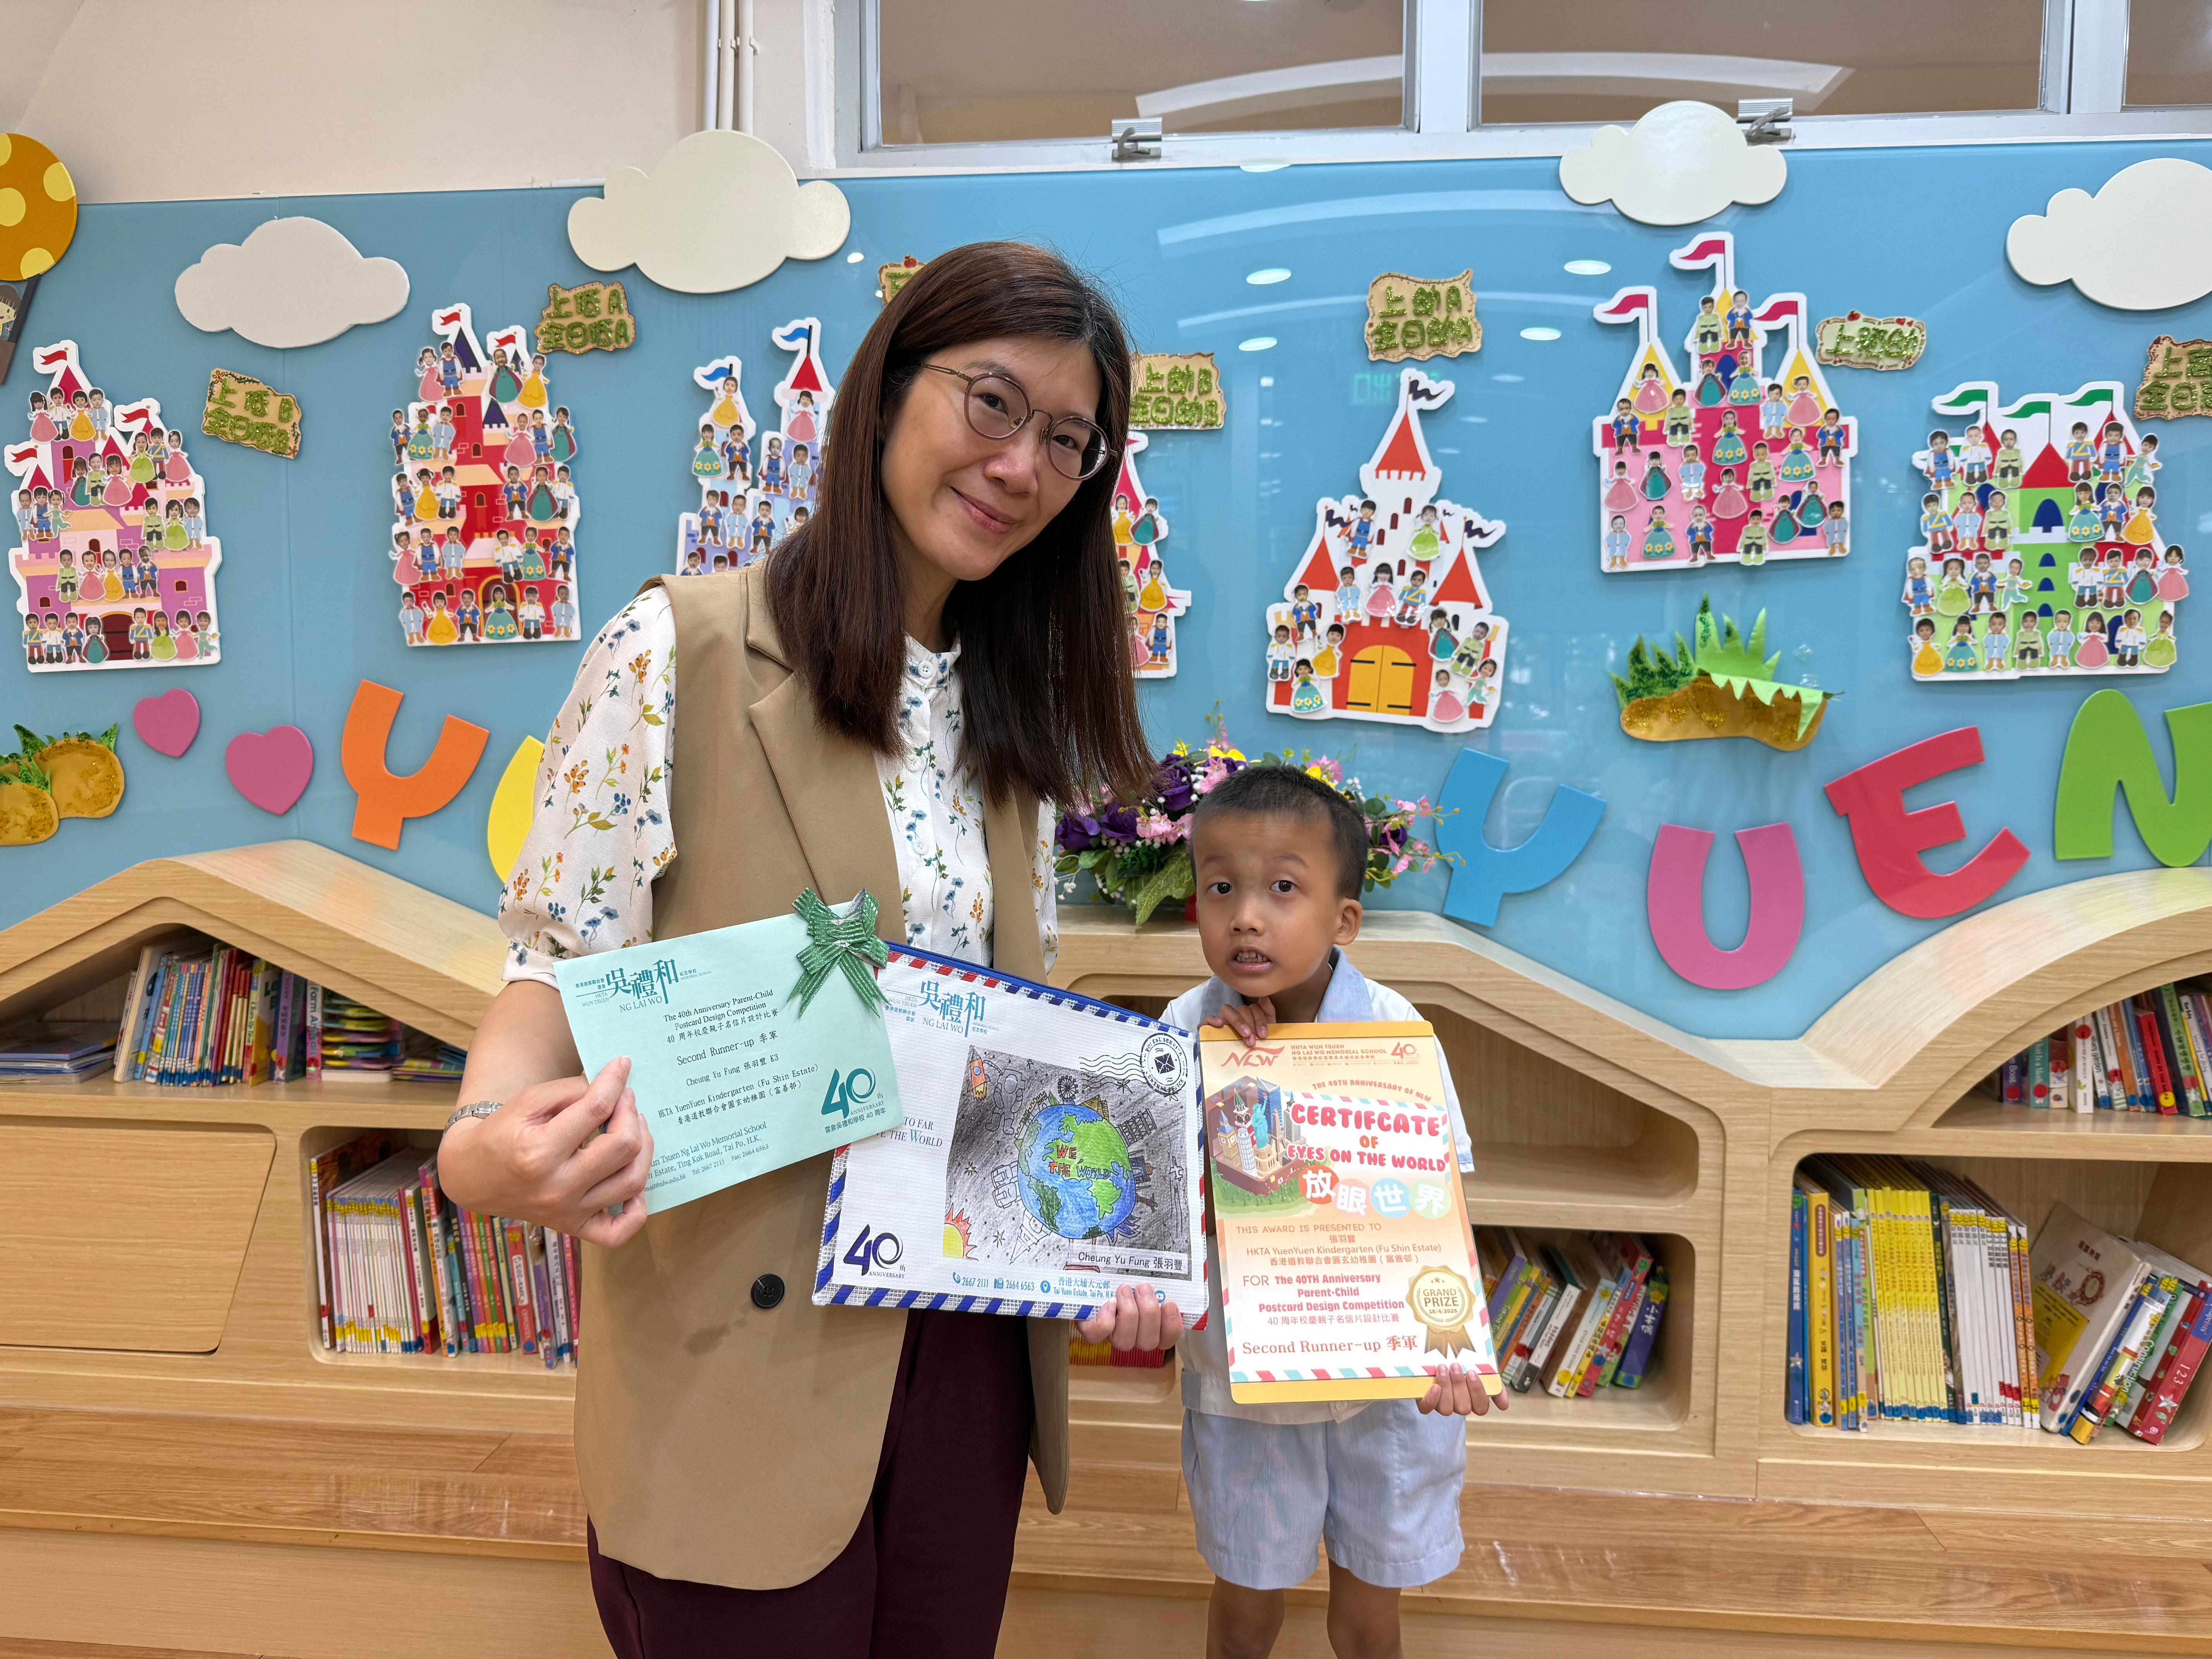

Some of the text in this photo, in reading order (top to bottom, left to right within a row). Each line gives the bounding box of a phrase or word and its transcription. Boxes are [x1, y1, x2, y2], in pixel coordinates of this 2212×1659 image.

[1434, 689, 2212, 990] YUEN
[606, 959, 679, 1004] 吳禮和
[310, 987, 318, 1013] Farm
[620, 996, 662, 1012] NG LAI WO
[678, 1010, 692, 1018] 40th
[694, 1000, 731, 1015] Anniversary
[733, 989, 773, 1005] Parent-Child
[918, 980, 986, 1037] 吳禮和
[675, 1003, 766, 1030] Postcard Design Competition
[923, 1017, 963, 1034] NG LAI WO
[667, 1035, 675, 1043] 40
[677, 1031, 778, 1065] Second Runner-up 季軍
[1391, 1042, 1417, 1059] 40
[686, 1075, 710, 1086] Cheung
[724, 1066, 740, 1075] Fung
[770, 1054, 779, 1063] K3
[658, 1064, 818, 1118] HKTA YuenYuen Kindergarten (Fu Shin Estate)
[821, 1066, 876, 1119] 40
[1312, 1081, 1326, 1089] THE
[1350, 1079, 1402, 1092] ANNIVERSARY
[1415, 1091, 1431, 1102] NLW
[850, 1101, 884, 1116] ANNIVERSARY
[875, 1108, 886, 1116] 周年
[904, 1117, 933, 1130] TO FAR
[1291, 1103, 1439, 1137] CERTIFCATE
[660, 1152, 680, 1163] Tsuen
[681, 1148, 690, 1157] Ng
[690, 1144, 699, 1154] Lai
[712, 1129, 742, 1146] Memorial
[744, 1121, 766, 1135] School
[890, 1130, 907, 1141] THE
[910, 1129, 943, 1147] WORLD
[1360, 1135, 1378, 1149] OF
[655, 1164, 676, 1177] Estate,
[677, 1159, 692, 1169] Ting
[692, 1154, 704, 1163] Kok
[705, 1148, 722, 1159] Road,
[723, 1143, 734, 1152] Tai
[735, 1140, 745, 1149] Po,
[747, 1135, 761, 1143] H.K.
[701, 1164, 712, 1173] 2667
[713, 1159, 725, 1168] 2111
[742, 1148, 755, 1158] 2664
[756, 1144, 769, 1153] 6563
[1288, 1145, 1446, 1172] EYES ON THE WORLD
[1049, 1161, 1111, 1180] THE WORLD
[1302, 1169, 1445, 1216] 放眼世界
[1314, 1223, 1365, 1231] PRESENTED
[1329, 1235, 1356, 1243] 張羽豐
[843, 1224, 903, 1276] 40
[1247, 1243, 1441, 1255] HKTA YuenYuen Kindergarten (Fu Shin Estate)
[1078, 1252, 1183, 1271] Cheung Yu Fung 張羽豐
[962, 1276, 988, 1288] 2667 2111
[1006, 1280, 1034, 1291] 2664 6563
[1243, 1274, 1381, 1287] FOR The 40TH Anniversary
[1061, 1288, 1072, 1296] Yuen
[1073, 1288, 1089, 1297] Estate,
[1297, 1287, 1360, 1297] Parent-Child
[1423, 1288, 1456, 1297] GRAND
[1259, 1299, 1404, 1312] Postcard Design Competition
[1424, 1297, 1459, 1307] PRIZE
[1267, 1314, 1400, 1325] 40 周年校慶親子名信片設計比賽
[1242, 1334, 1417, 1354] Second Runner-up 季軍
[2121, 1340, 2155, 1393] Construction
